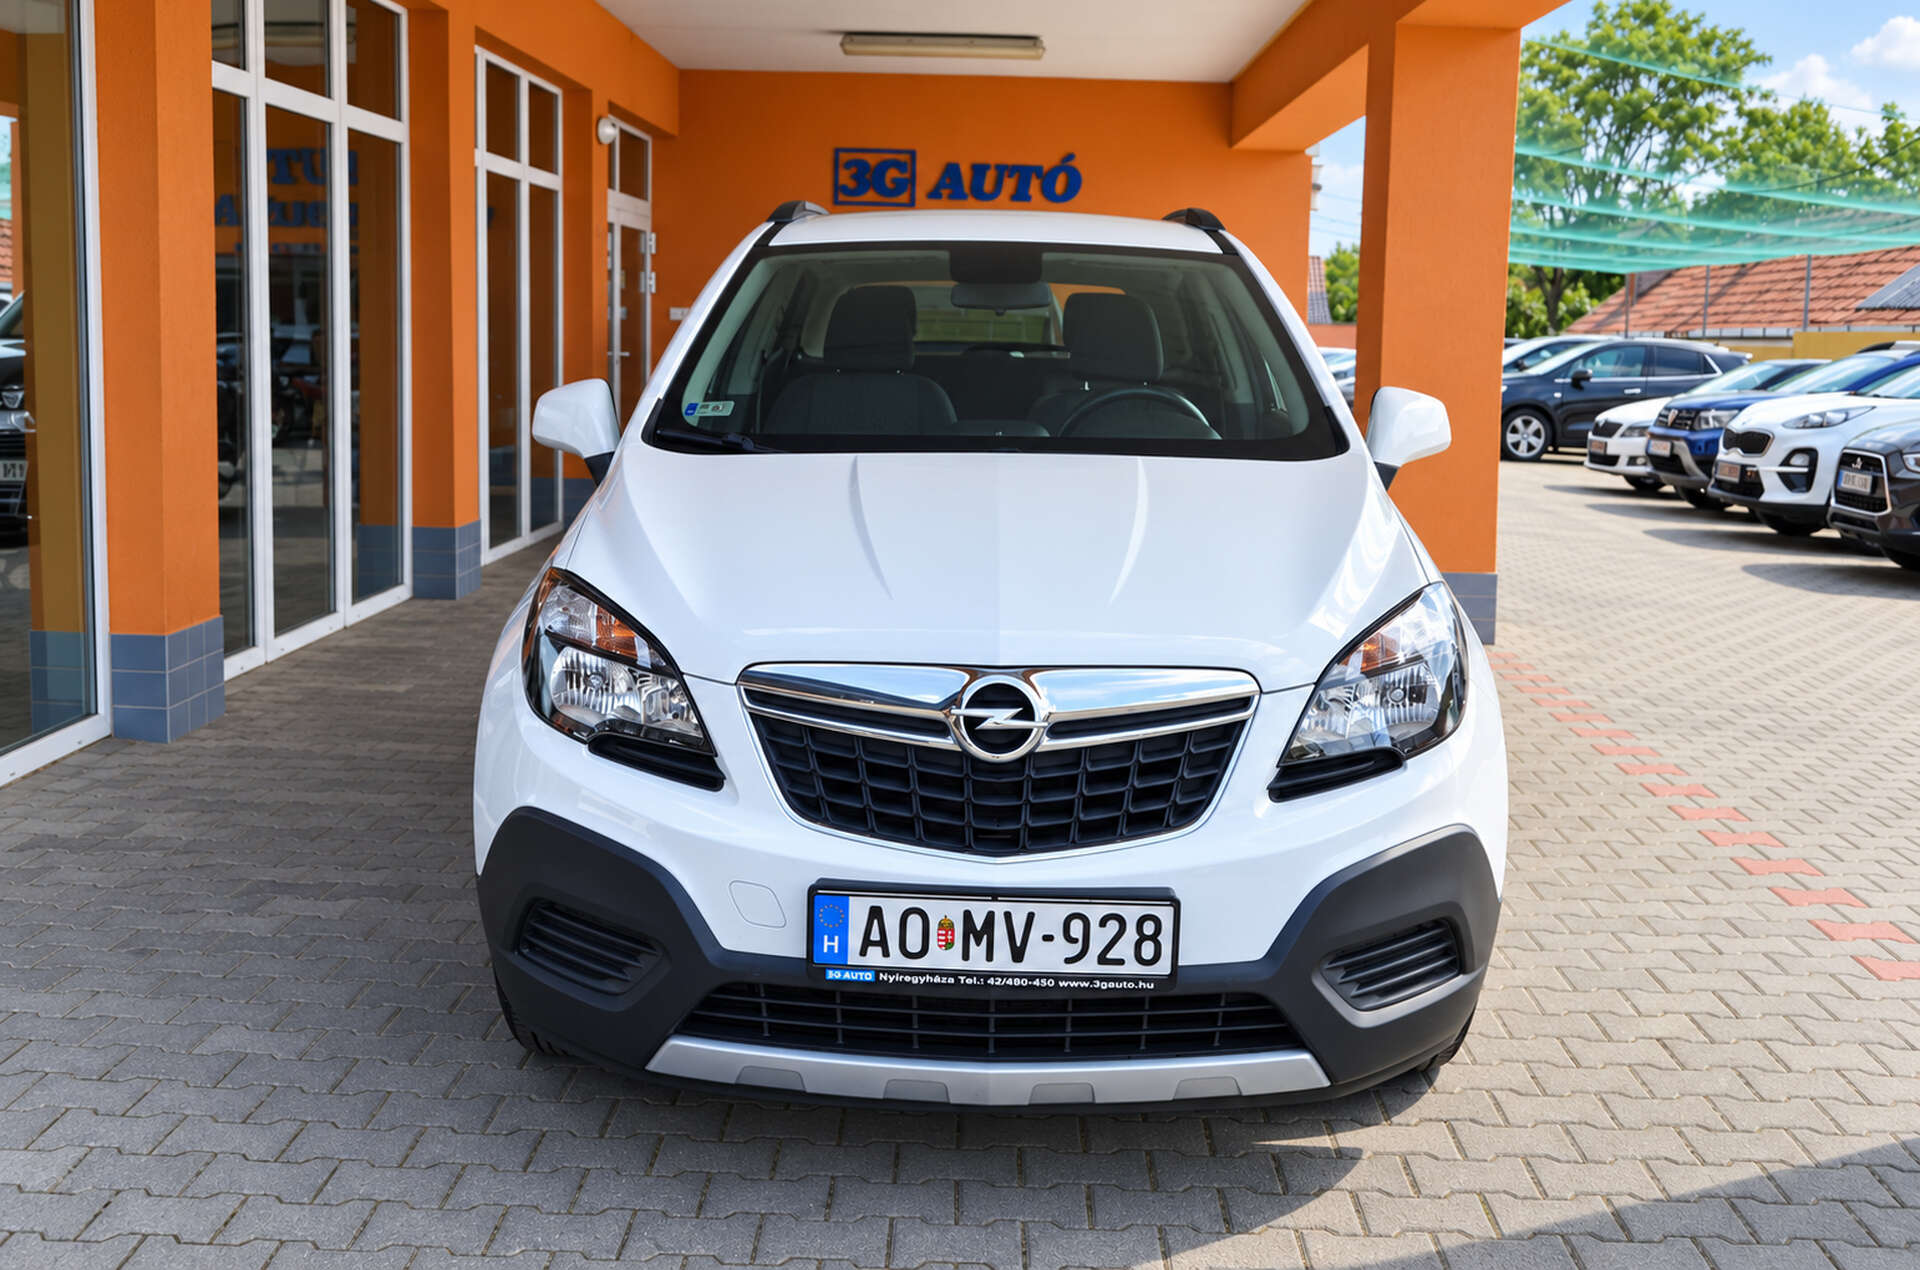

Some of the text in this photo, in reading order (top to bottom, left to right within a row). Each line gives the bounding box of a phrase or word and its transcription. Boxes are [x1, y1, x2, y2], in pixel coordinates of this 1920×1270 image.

[838, 153, 1083, 204] 3G AUTÓ
[823, 934, 840, 954] H
[859, 905, 1163, 967] AO MV-928
[957, 975, 985, 986] Tel.:
[1058, 979, 1155, 990] www.3gauto.hu
